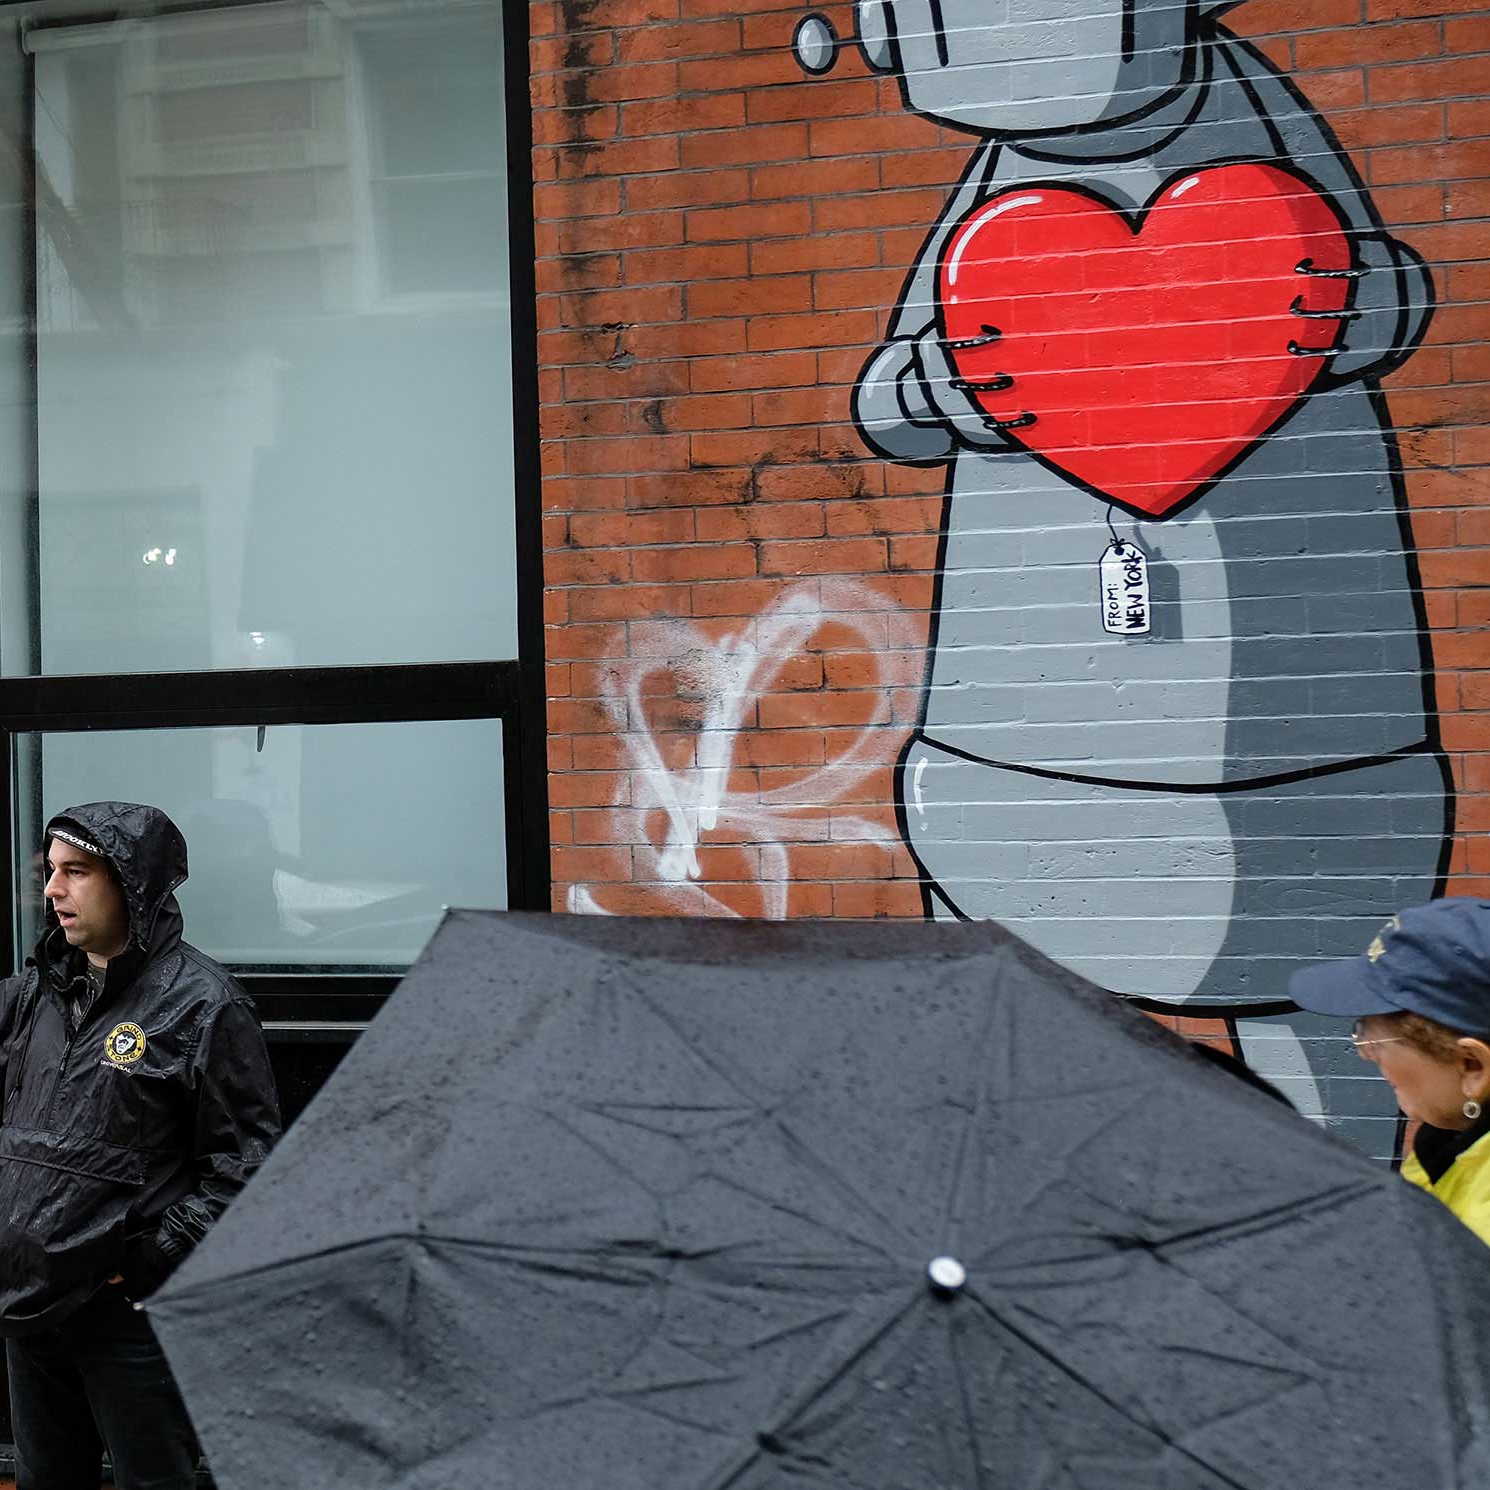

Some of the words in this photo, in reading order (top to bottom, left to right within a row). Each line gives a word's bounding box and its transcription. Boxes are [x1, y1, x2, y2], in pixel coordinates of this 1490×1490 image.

[1121, 550, 1143, 591] YORK
[1107, 583, 1122, 627] FROM:
[1125, 594, 1146, 629] NEW
